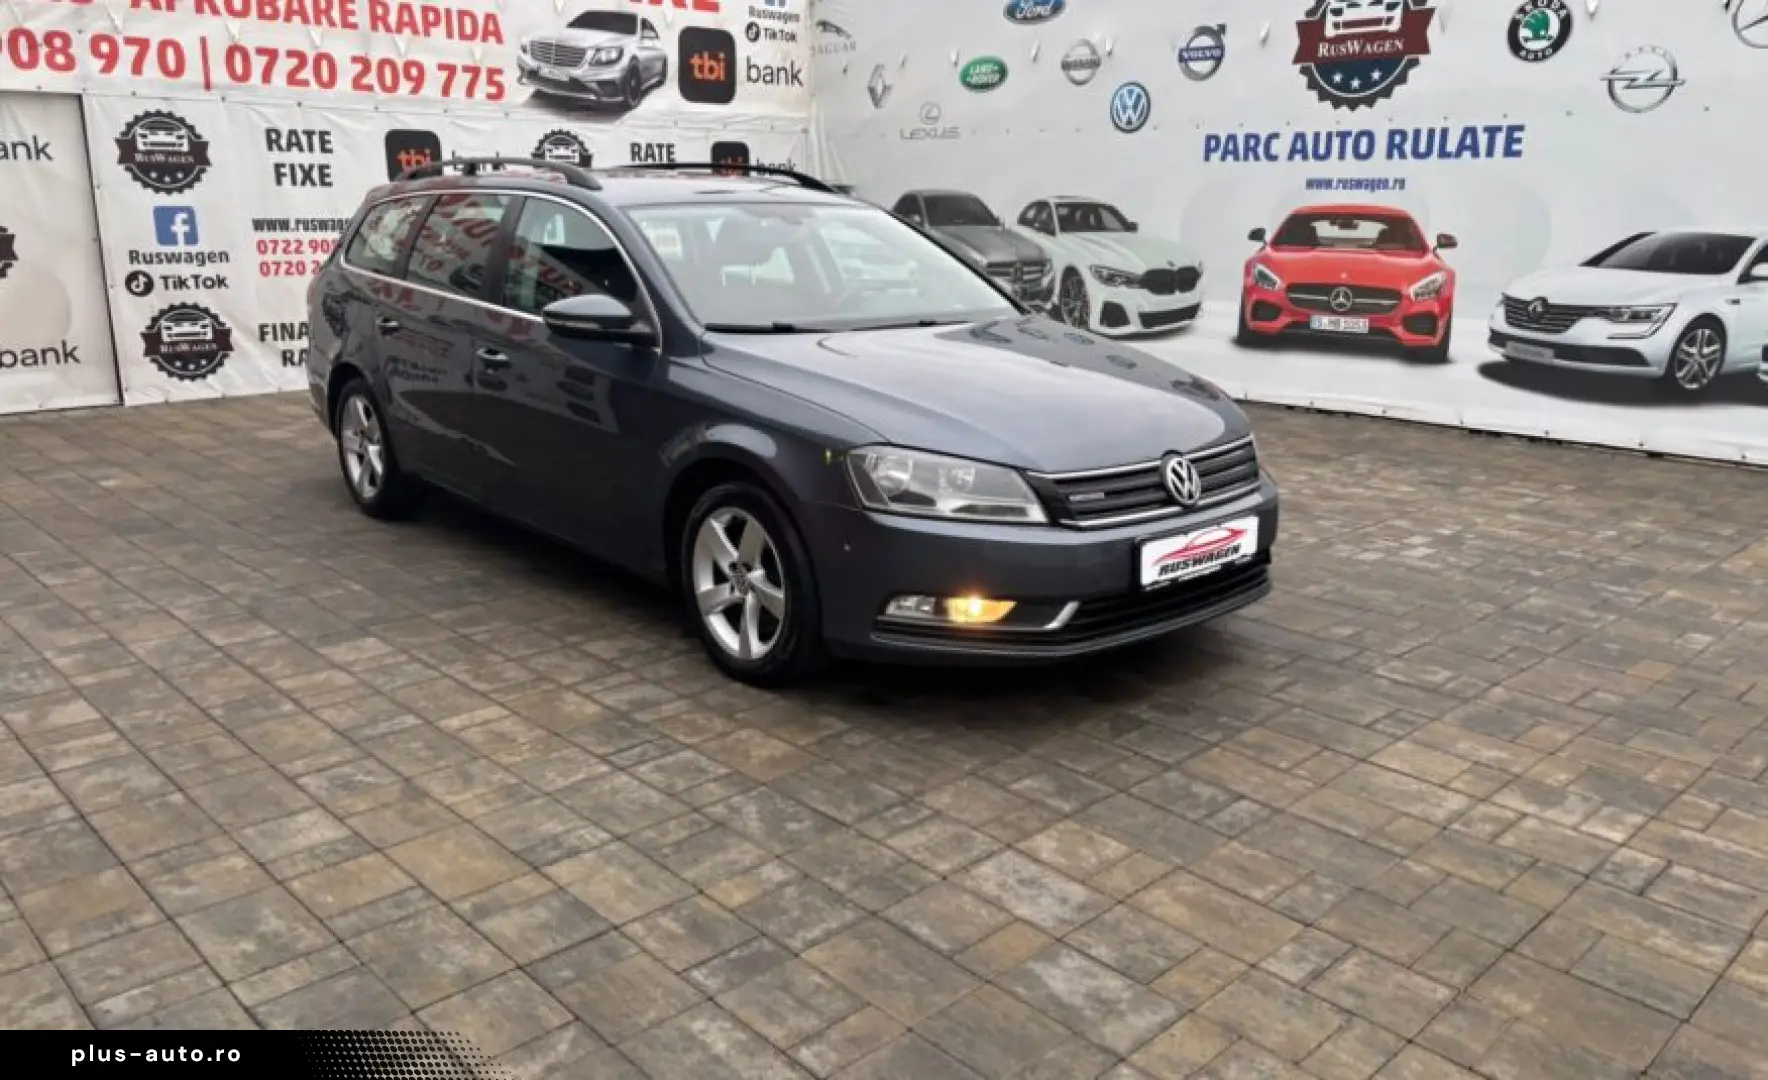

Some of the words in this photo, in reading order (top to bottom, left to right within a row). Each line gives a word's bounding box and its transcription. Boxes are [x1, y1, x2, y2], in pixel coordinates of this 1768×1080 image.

[369, 0, 504, 44] RAPIDA
[763, 28, 798, 42] TikTok
[1181, 49, 1222, 59] VOLVO
[0, 27, 76, 72] 08
[90, 33, 187, 78] 970
[225, 43, 338, 89] 0720
[350, 54, 426, 95] 209
[436, 62, 505, 101] 775
[688, 52, 727, 82] tbi
[746, 56, 804, 88] bank
[265, 128, 333, 154] RATE
[899, 126, 961, 140] LEXUS
[630, 142, 676, 163] RATE
[1203, 132, 1280, 163] PARC
[1287, 129, 1376, 162] AUTO
[1386, 124, 1526, 160] RULATE
[273, 163, 333, 187] FIXE
[1304, 177, 1405, 192] www.ruswagen.ro
[257, 238, 304, 255] 0722
[128, 249, 229, 267] Ruswagen
[259, 261, 307, 277] 0720
[160, 274, 229, 291] TikTok
